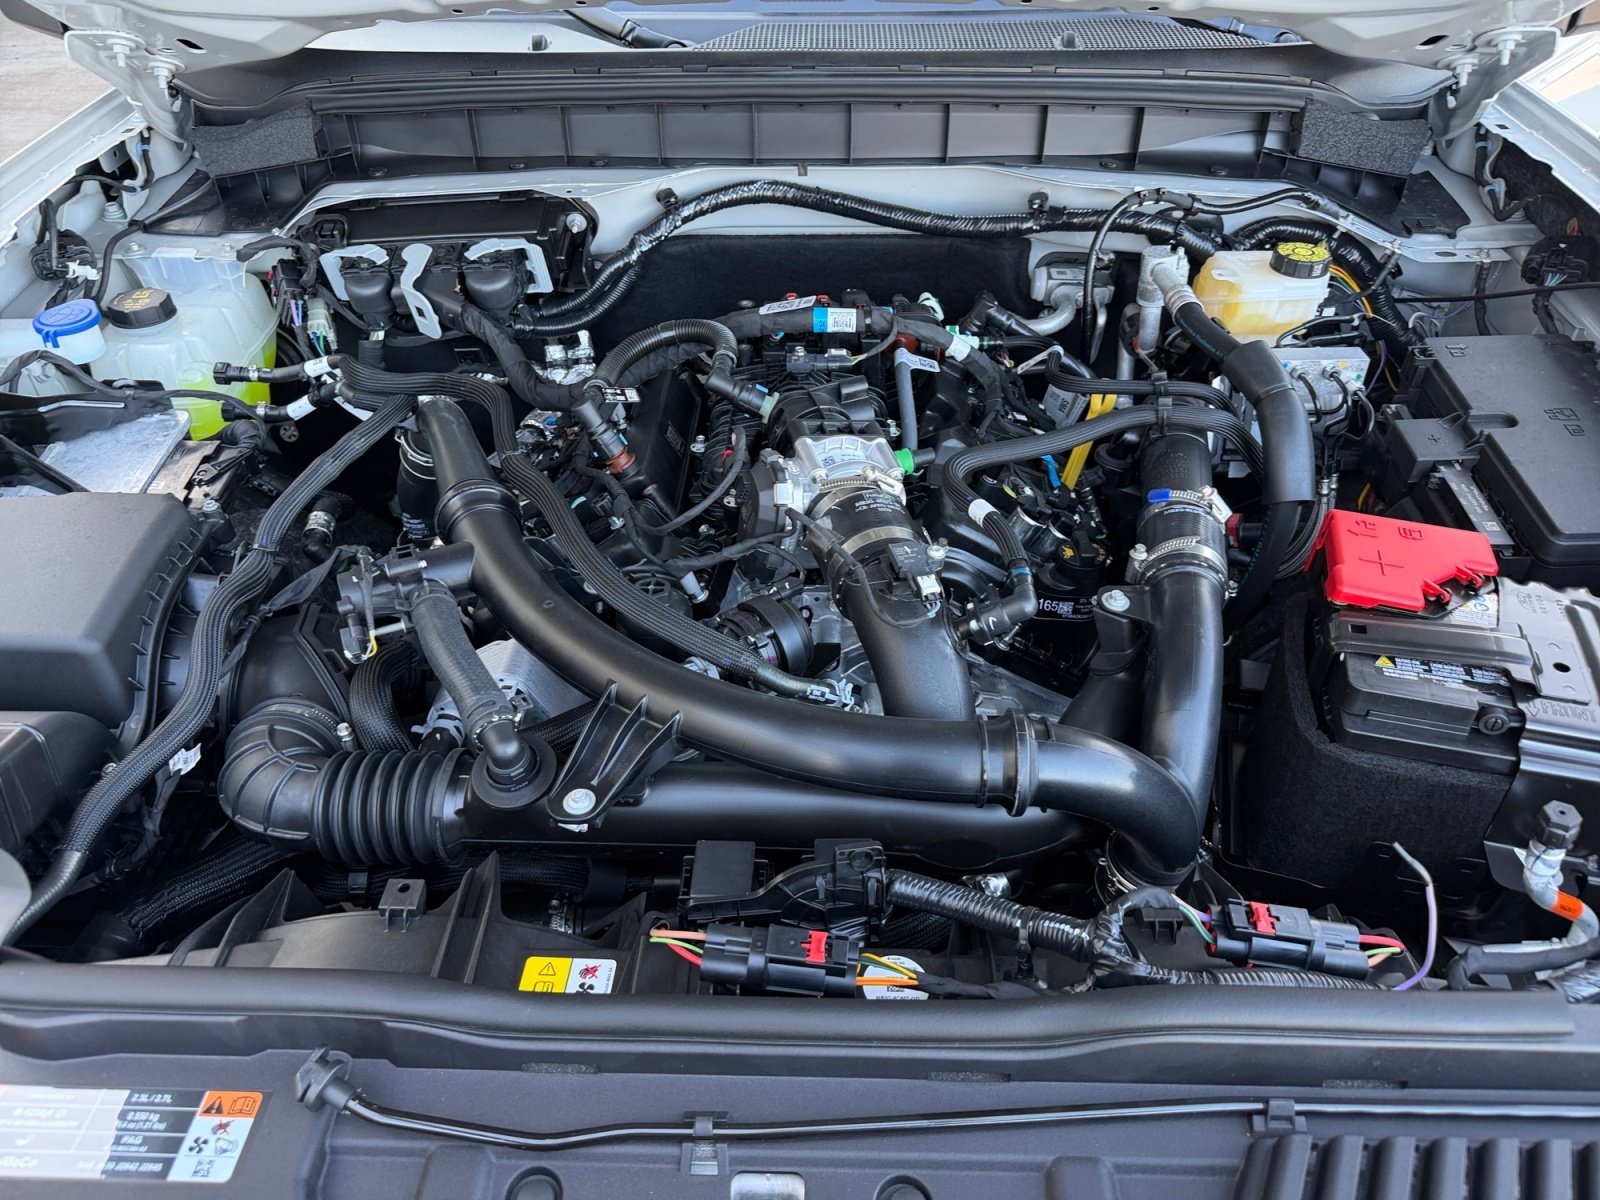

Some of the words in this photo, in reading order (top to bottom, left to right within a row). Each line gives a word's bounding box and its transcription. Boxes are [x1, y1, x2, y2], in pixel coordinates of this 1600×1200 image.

[1039, 598, 1058, 611] 165
[154, 1094, 173, 1103] 2.7L
[126, 1111, 149, 1121] 0.550
[149, 1112, 160, 1122] kg
[120, 1135, 144, 1145] PAG
